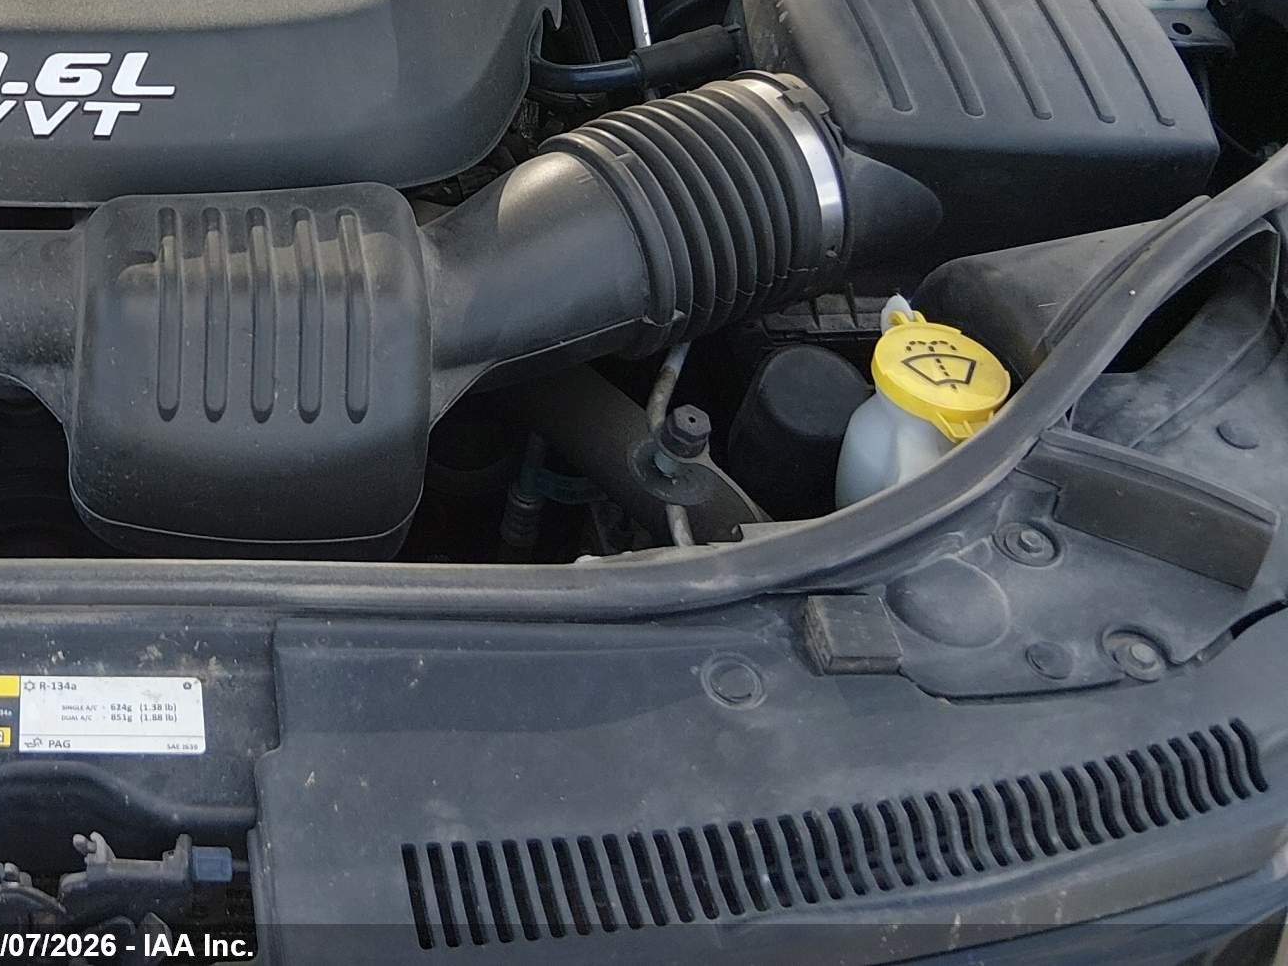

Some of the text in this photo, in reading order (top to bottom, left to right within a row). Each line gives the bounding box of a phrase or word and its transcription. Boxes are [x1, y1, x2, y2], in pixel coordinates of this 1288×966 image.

[39, 681, 77, 691] R-134a
[165, 703, 177, 712] lb)
[165, 714, 178, 722] lb)
[48, 739, 71, 748] PAG
